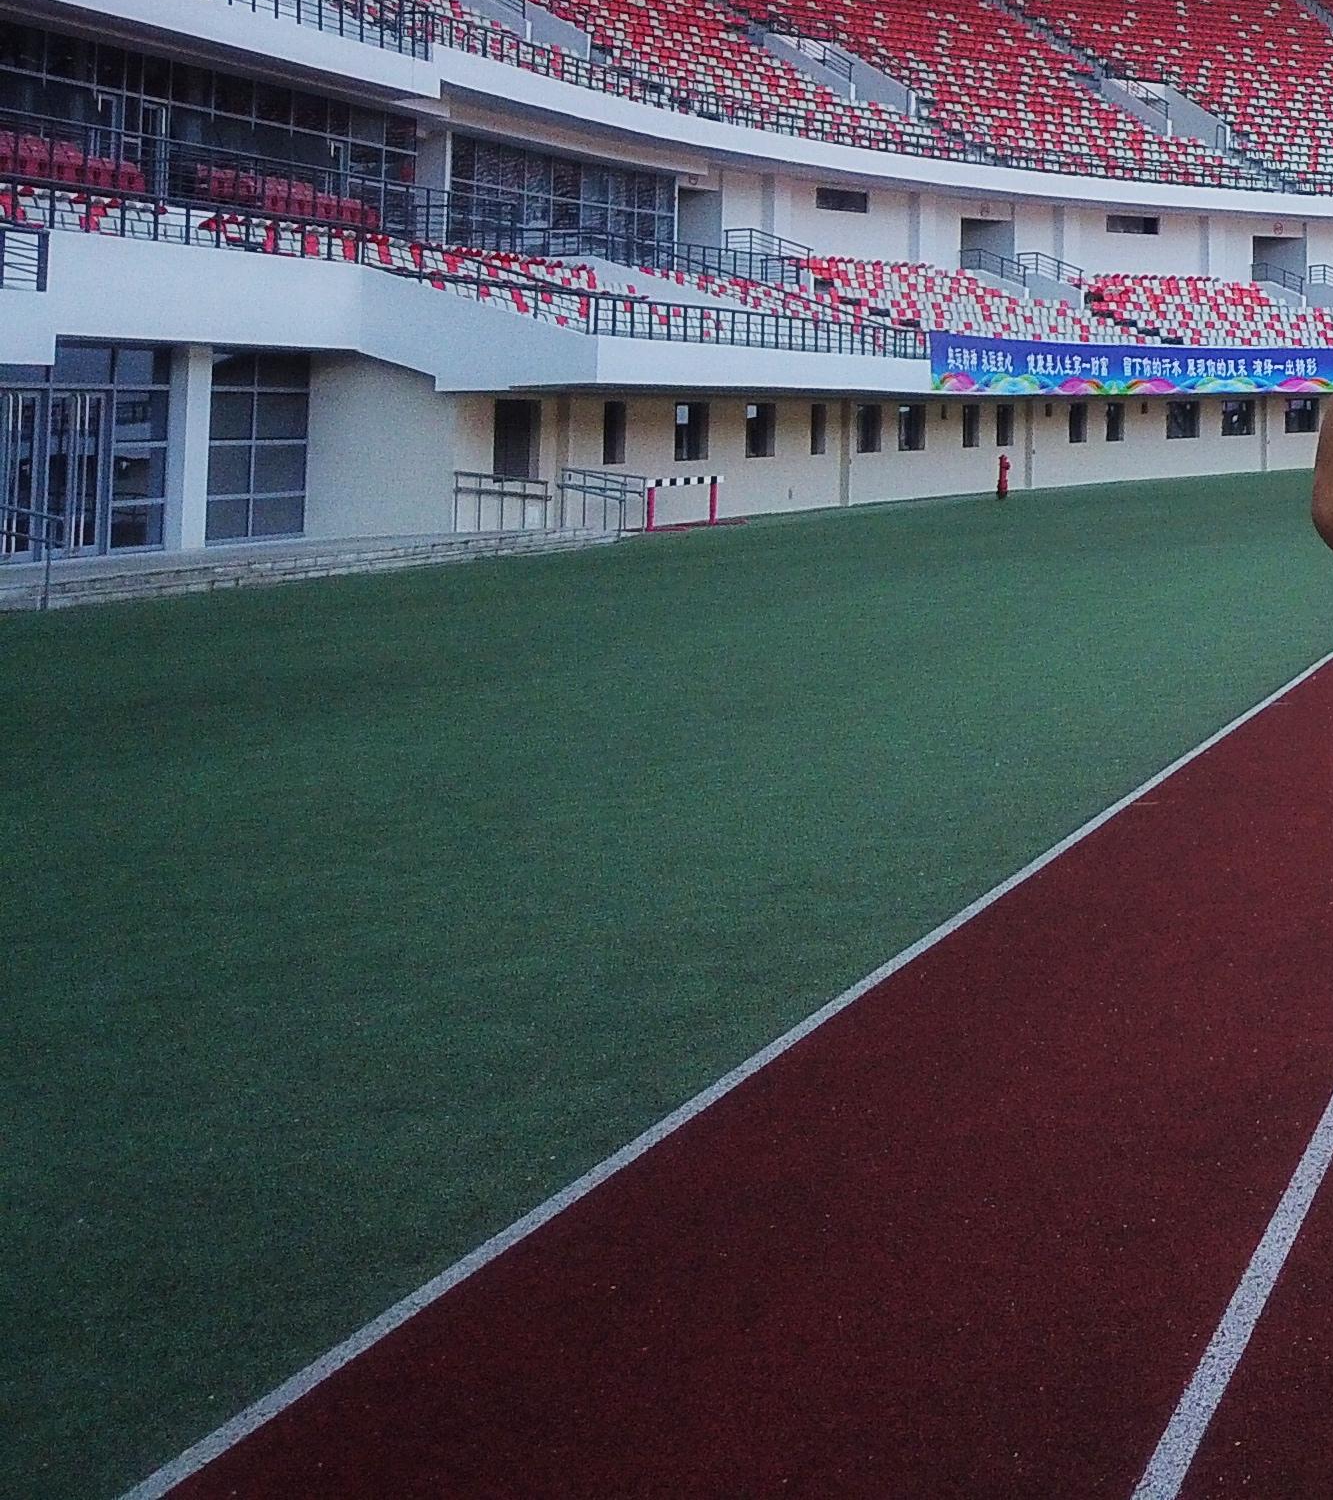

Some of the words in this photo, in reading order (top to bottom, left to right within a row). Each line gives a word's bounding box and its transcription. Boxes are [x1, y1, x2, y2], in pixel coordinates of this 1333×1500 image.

[1123, 355, 1182, 378] 留下你的汗水
[1186, 356, 1248, 378] 展现你的风采
